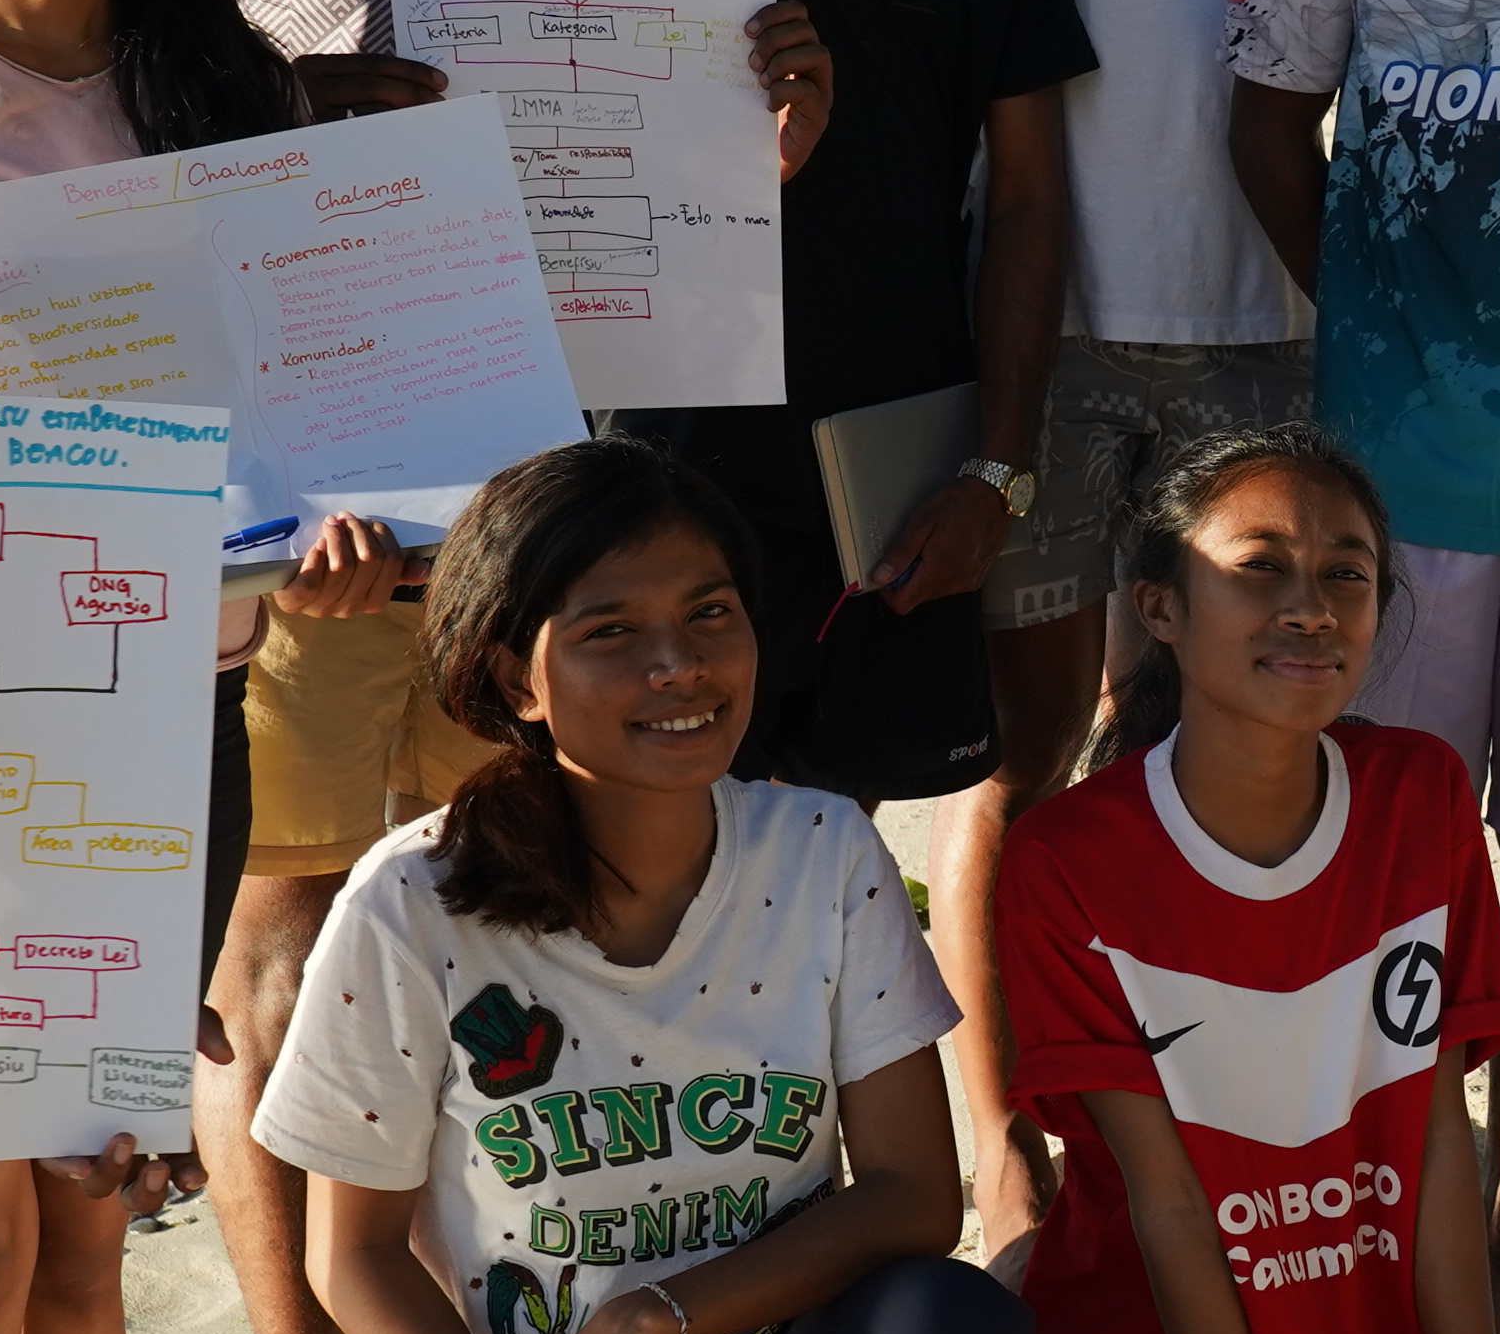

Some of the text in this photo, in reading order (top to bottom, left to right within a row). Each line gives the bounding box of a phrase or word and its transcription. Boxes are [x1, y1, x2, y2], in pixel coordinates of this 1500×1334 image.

[662, 23, 688, 43] Lei
[511, 95, 563, 118] LMMA
[475, 1071, 826, 1189] SINCE
[529, 1175, 770, 1266] DENIM
